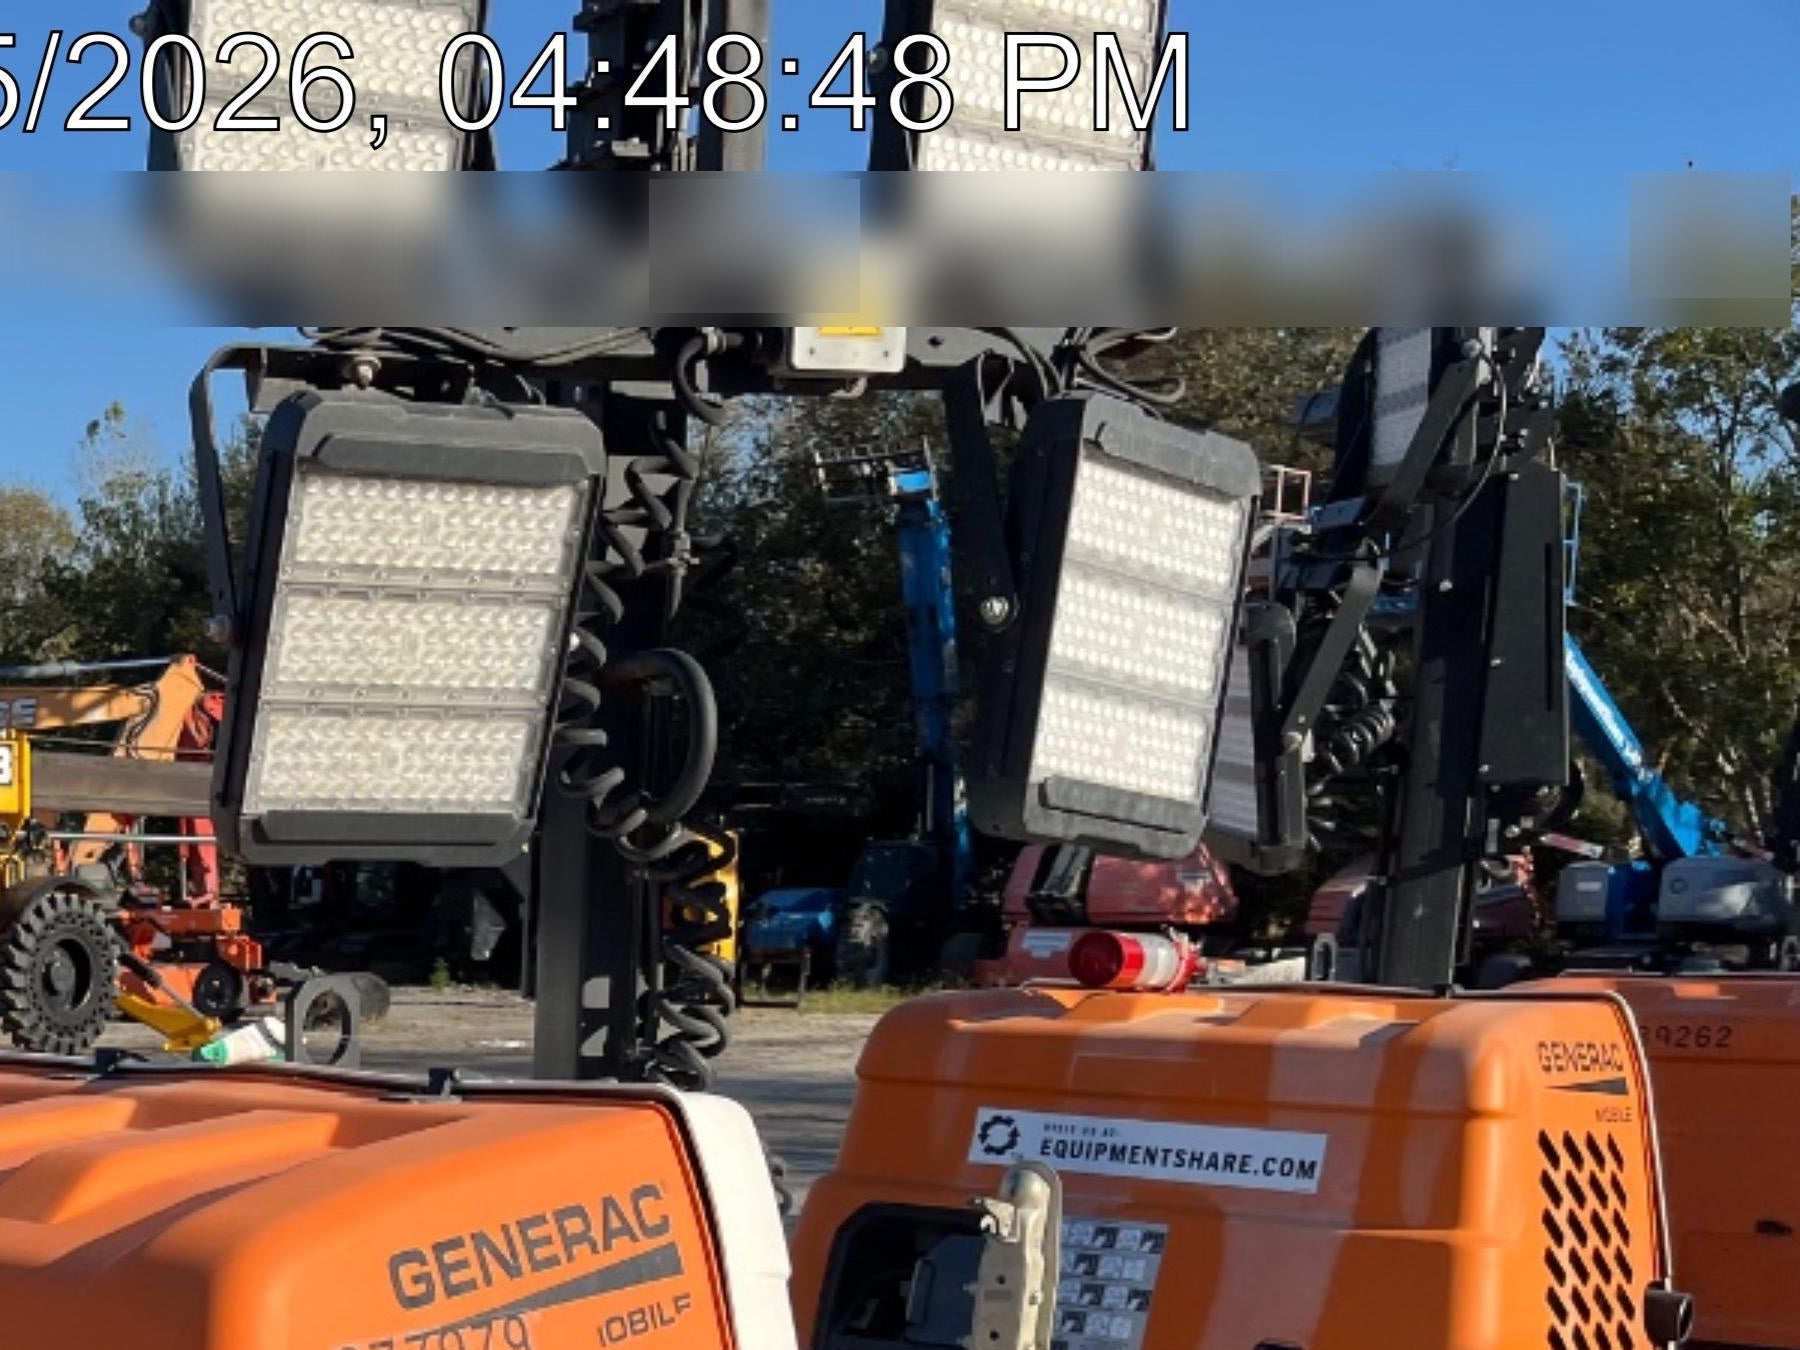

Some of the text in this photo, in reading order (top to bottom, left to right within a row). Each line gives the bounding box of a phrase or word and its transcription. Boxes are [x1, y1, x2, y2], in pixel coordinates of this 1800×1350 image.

[1537, 1041, 1624, 1072] GENERAC
[1040, 1137, 1318, 1180] EQUIPMENTSHARE.COM
[388, 1182, 671, 1310] GENERAC
